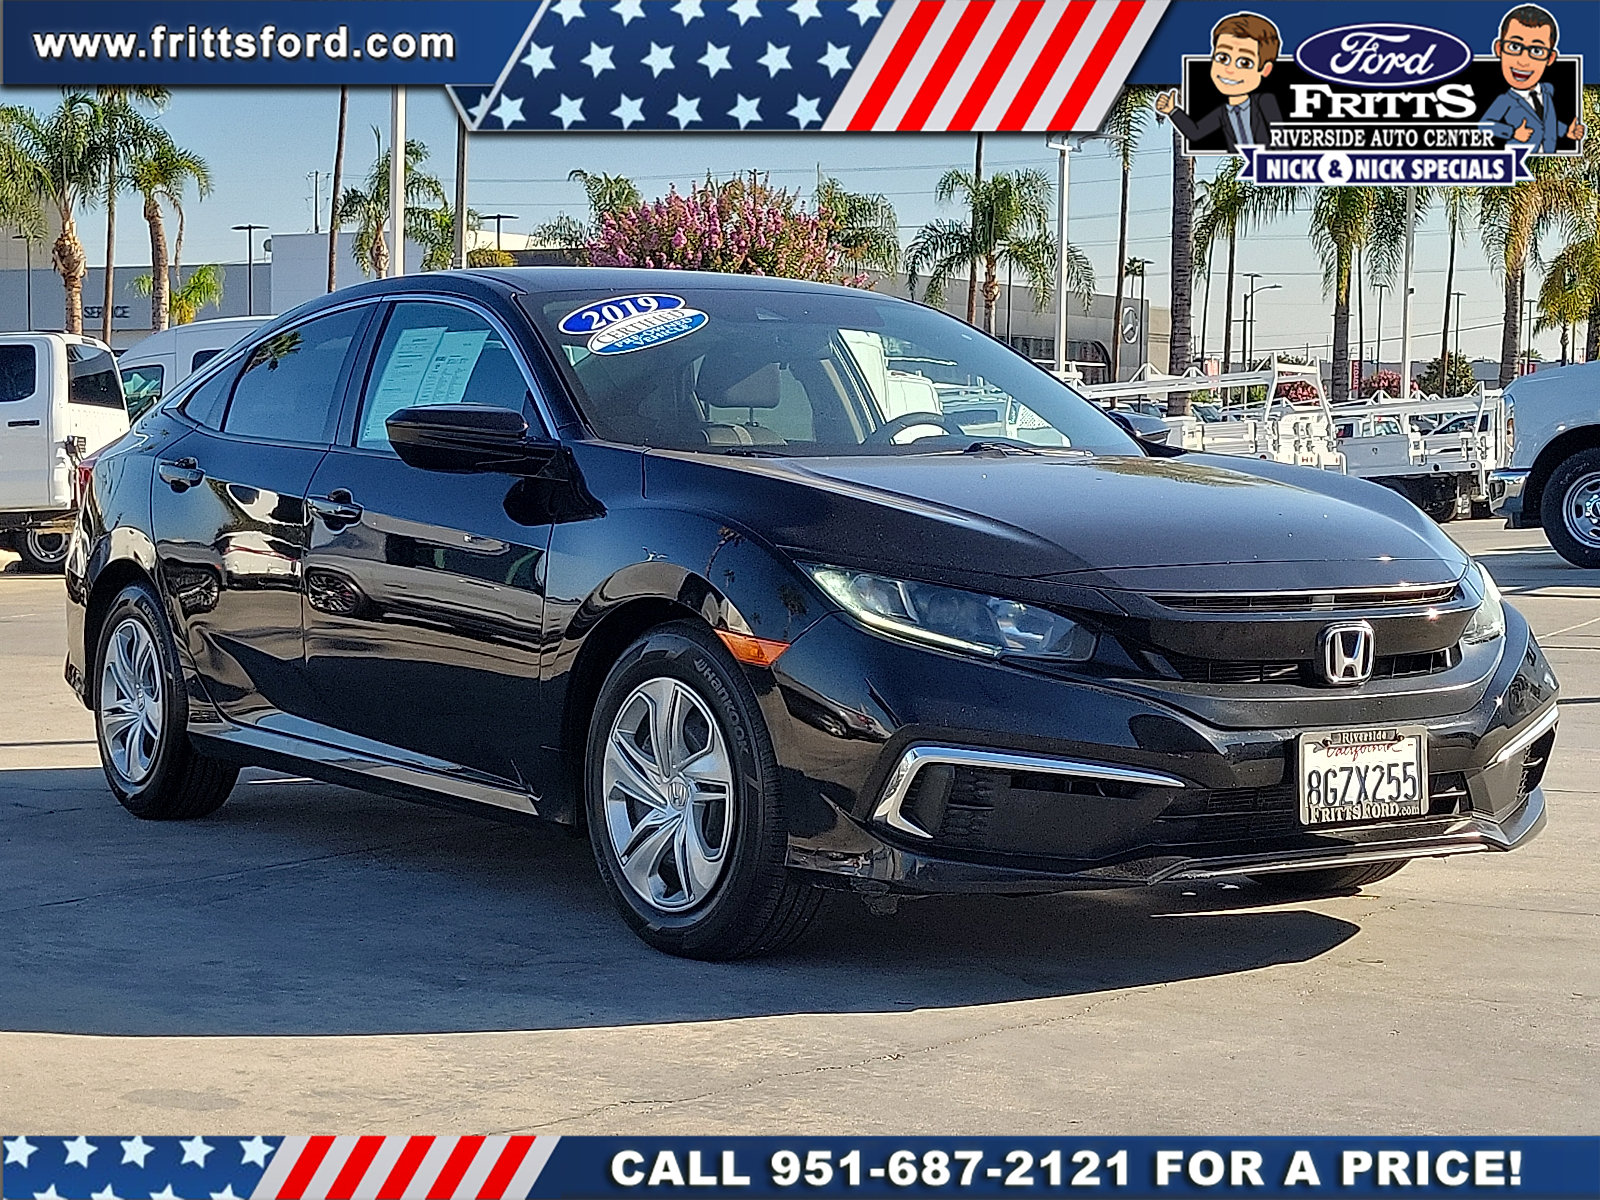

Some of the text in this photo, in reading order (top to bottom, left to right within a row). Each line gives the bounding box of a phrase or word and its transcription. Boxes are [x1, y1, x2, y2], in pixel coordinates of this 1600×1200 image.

[84, 306, 130, 318] SERICE
[582, 296, 659, 330] 2019
[597, 310, 685, 343] CERTIFIED
[633, 325, 693, 346] VEHICLE
[1342, 730, 1387, 743] Riverside
[1307, 762, 1417, 806] 8GZX255
